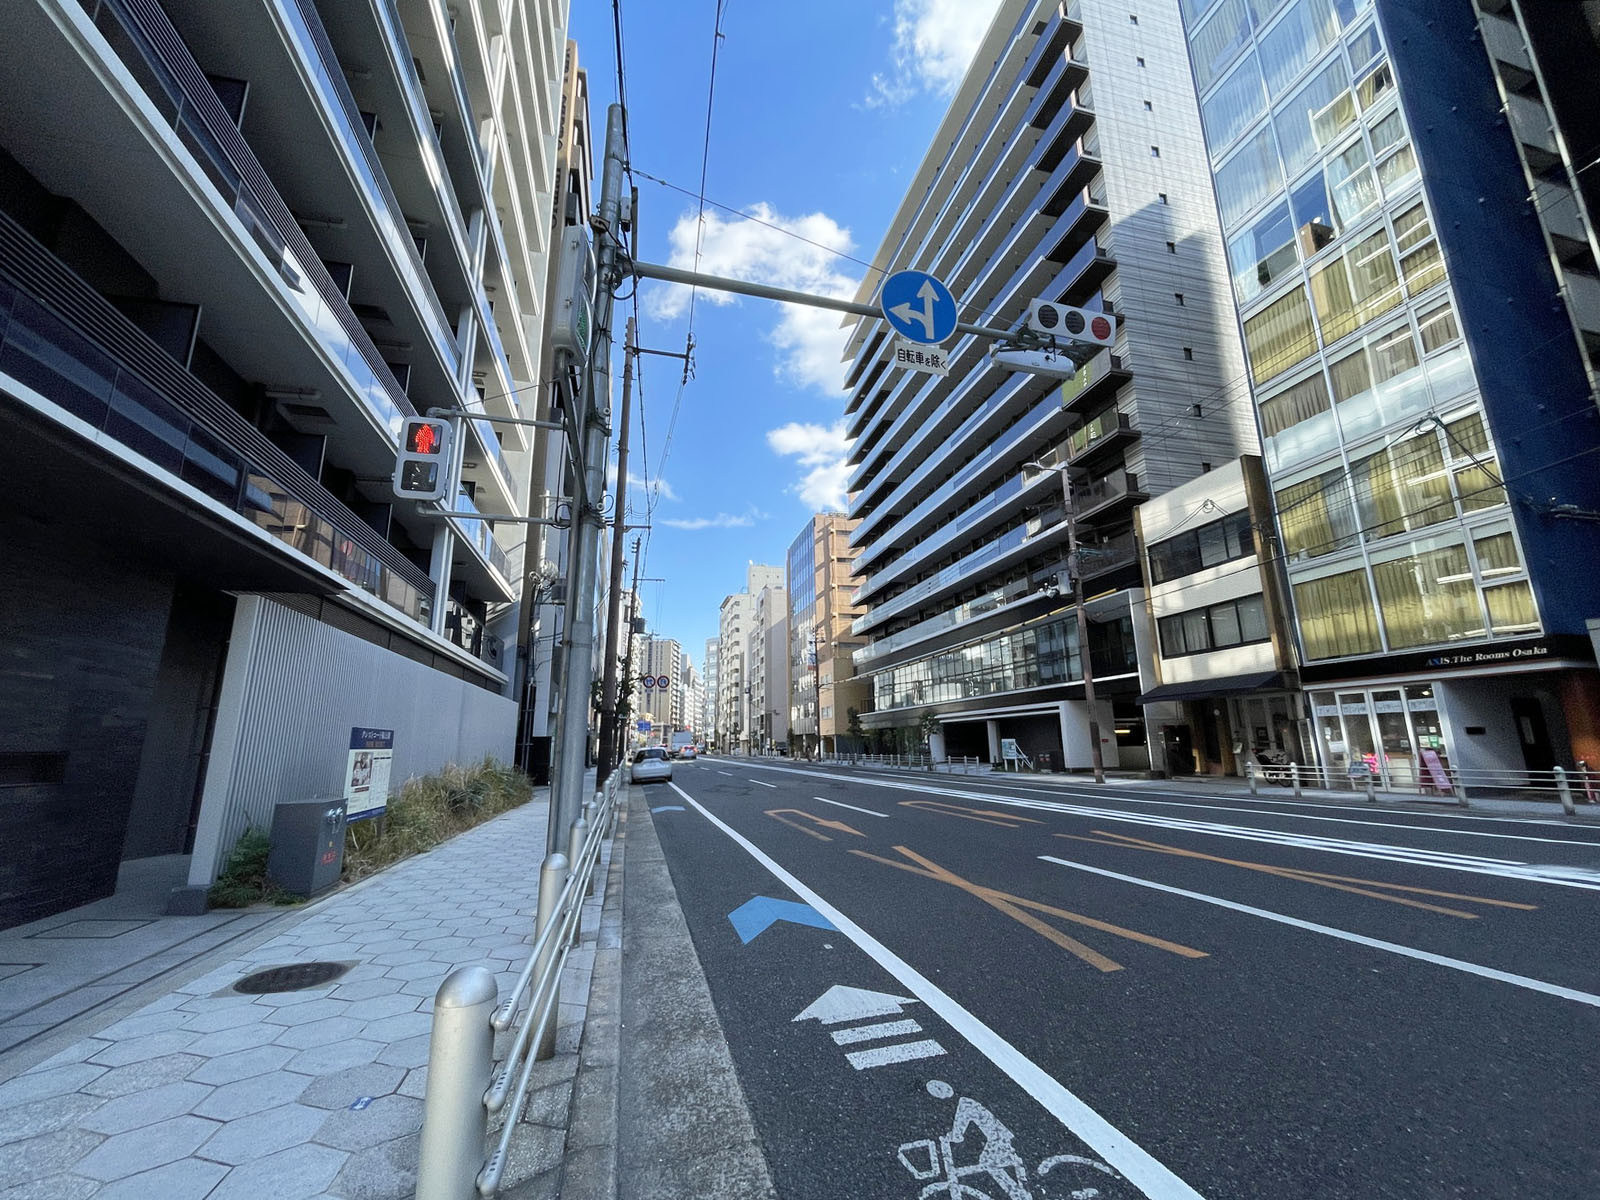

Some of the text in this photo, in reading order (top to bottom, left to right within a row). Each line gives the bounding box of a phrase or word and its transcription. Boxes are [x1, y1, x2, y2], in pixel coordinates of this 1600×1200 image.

[897, 348, 946, 369] 自転車を除く
[1475, 651, 1509, 661] Rooms
[1512, 646, 1548, 657] Osaka
